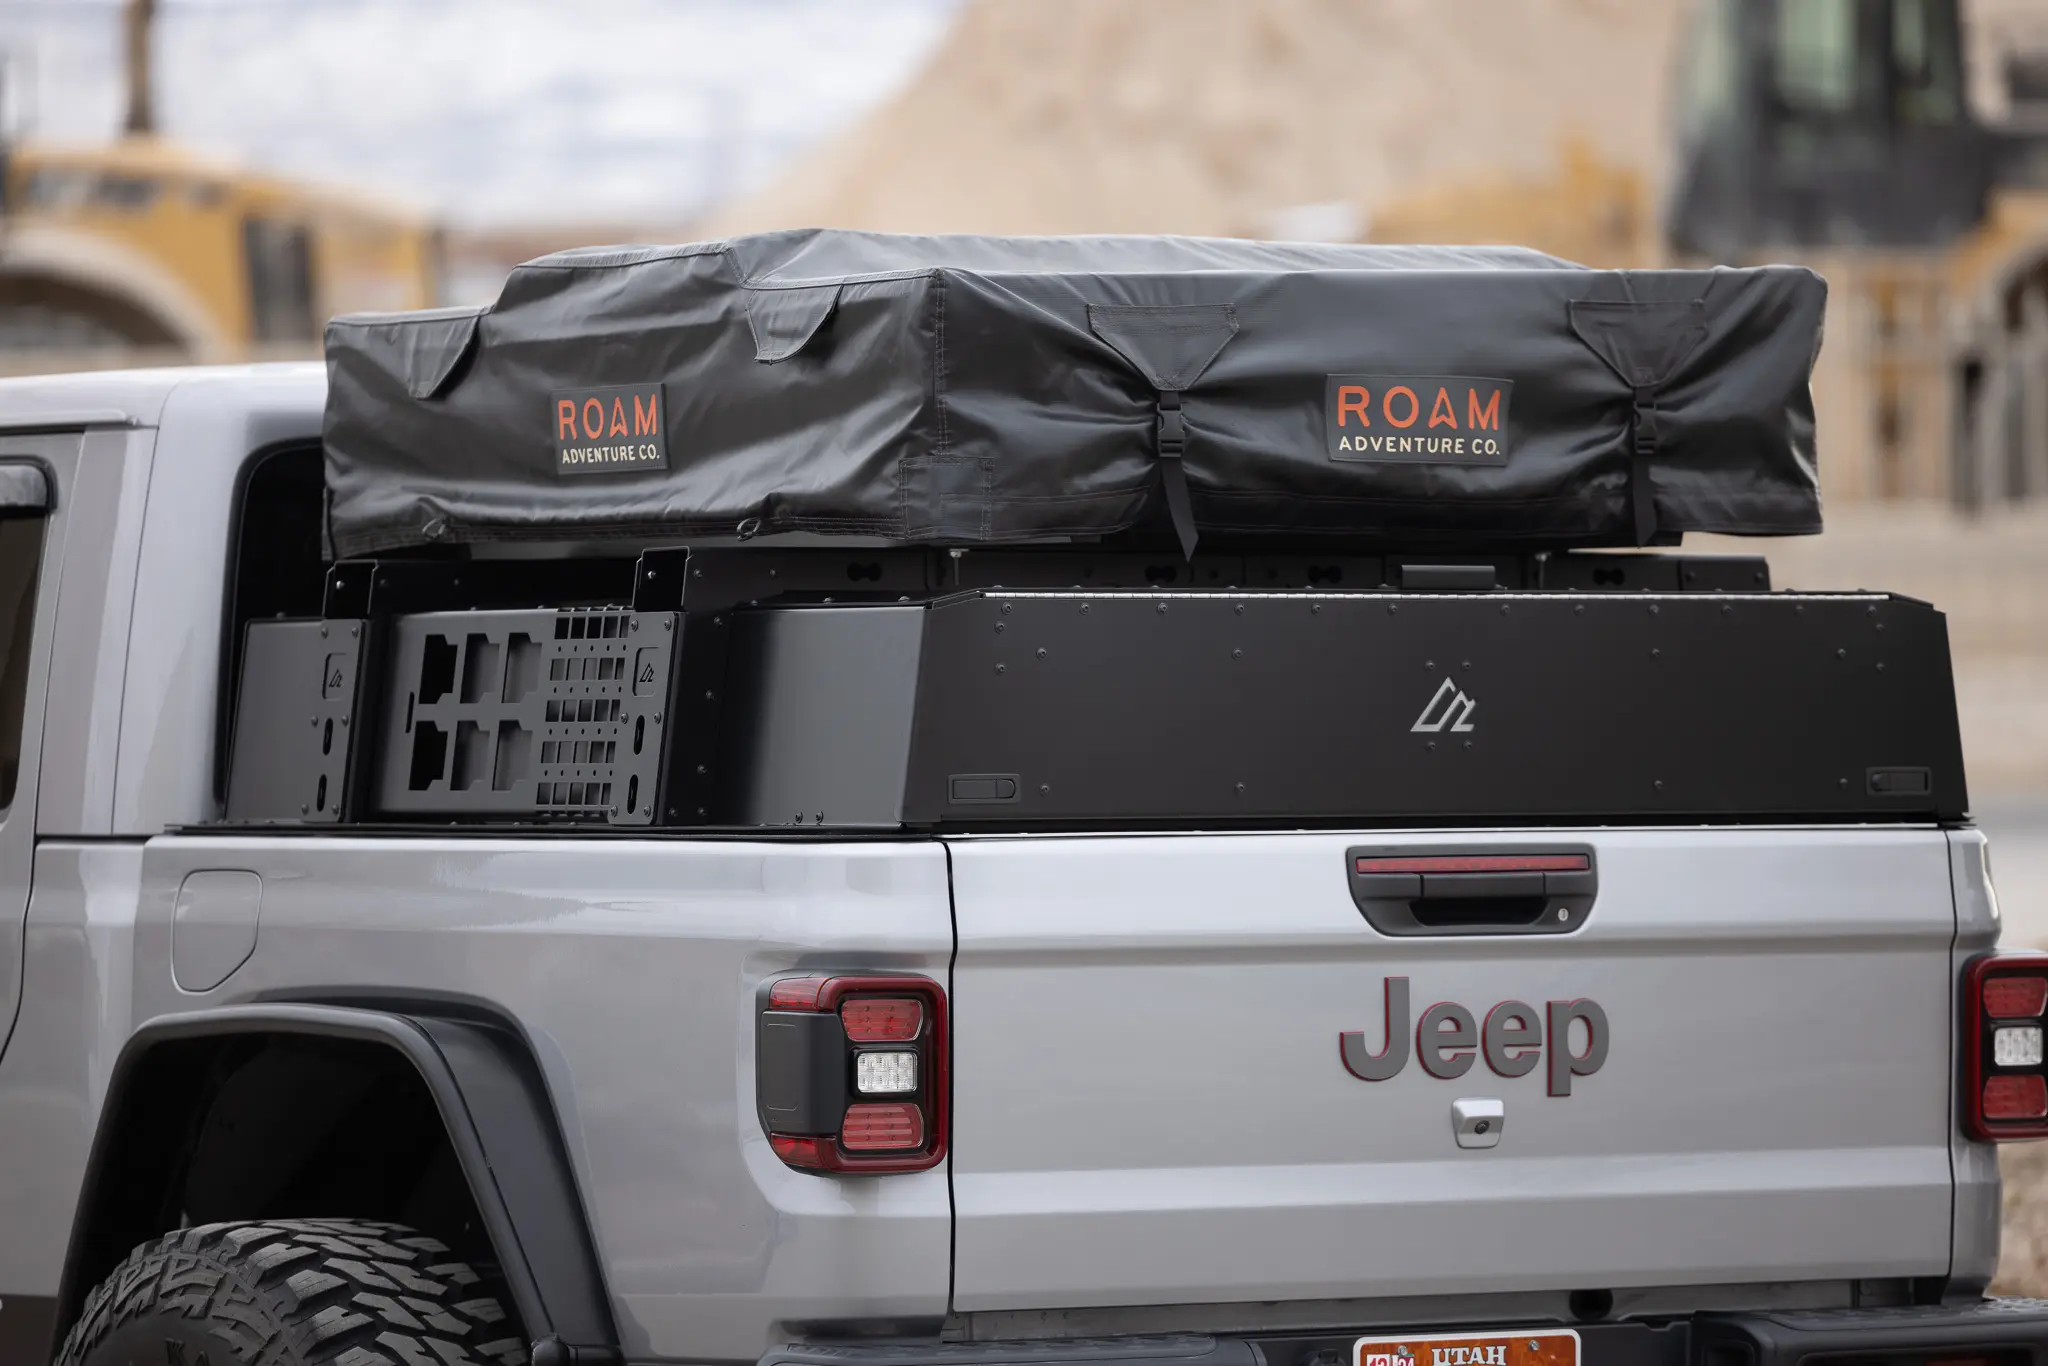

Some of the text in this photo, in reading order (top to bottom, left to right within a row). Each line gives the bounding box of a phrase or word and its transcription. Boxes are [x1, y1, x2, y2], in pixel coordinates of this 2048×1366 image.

[557, 393, 658, 441] ROAM
[1337, 385, 1501, 431] ROAM
[562, 443, 661, 465] ADVENTURE CO.
[1338, 435, 1500, 456] ADVENTURE CO.
[1339, 976, 1610, 1098] Jeep
[1431, 1345, 1507, 1366] UTAH
